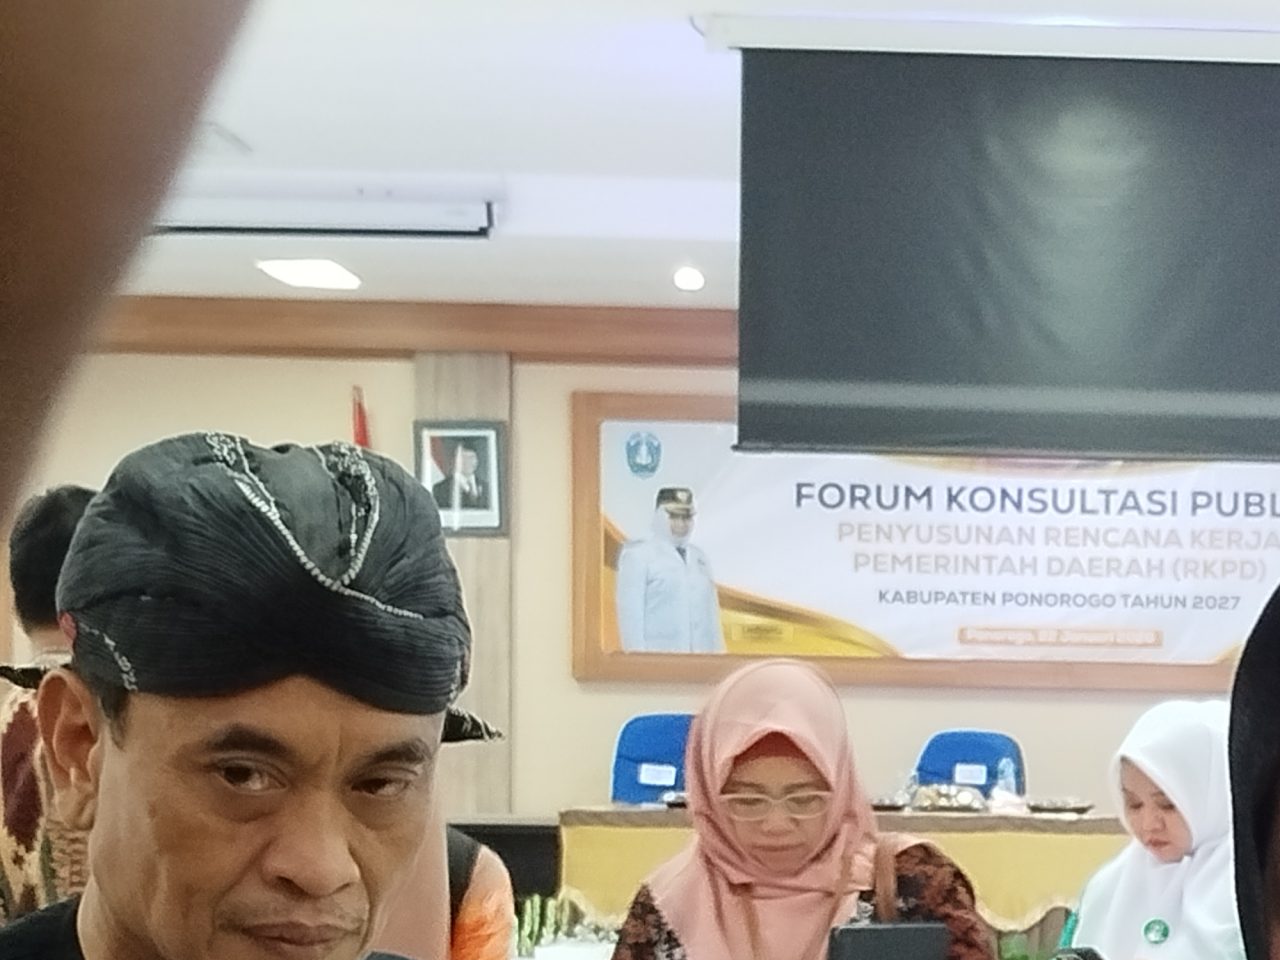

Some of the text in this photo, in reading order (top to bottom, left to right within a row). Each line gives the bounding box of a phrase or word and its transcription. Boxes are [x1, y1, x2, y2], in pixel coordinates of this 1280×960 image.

[795, 482, 933, 513] FORUM
[946, 486, 1178, 516] KONSULTASI
[837, 521, 1036, 547] PENYUSUNAN
[1044, 525, 1183, 550] RENCANA
[853, 551, 1268, 583] PEMERINTAH DAERAH (RKPD)
[878, 588, 1242, 611] KABUPATEN PONOROGO TAHUN 2027
